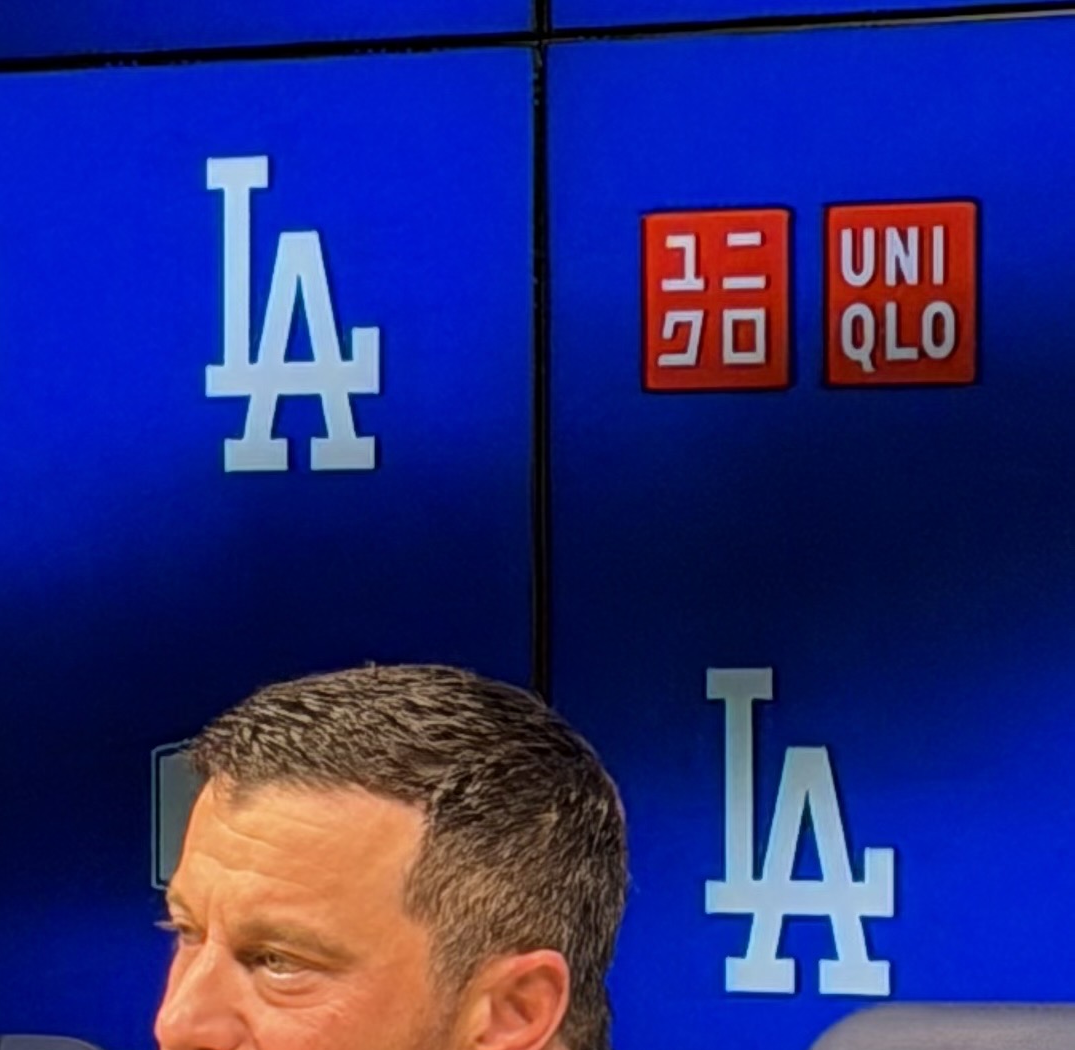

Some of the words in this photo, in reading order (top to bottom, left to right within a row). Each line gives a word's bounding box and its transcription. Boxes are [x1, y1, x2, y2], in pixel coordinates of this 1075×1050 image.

[205, 156, 380, 472] LA
[841, 225, 944, 287] UNI
[841, 301, 956, 373] QLO
[705, 668, 895, 996] LA
